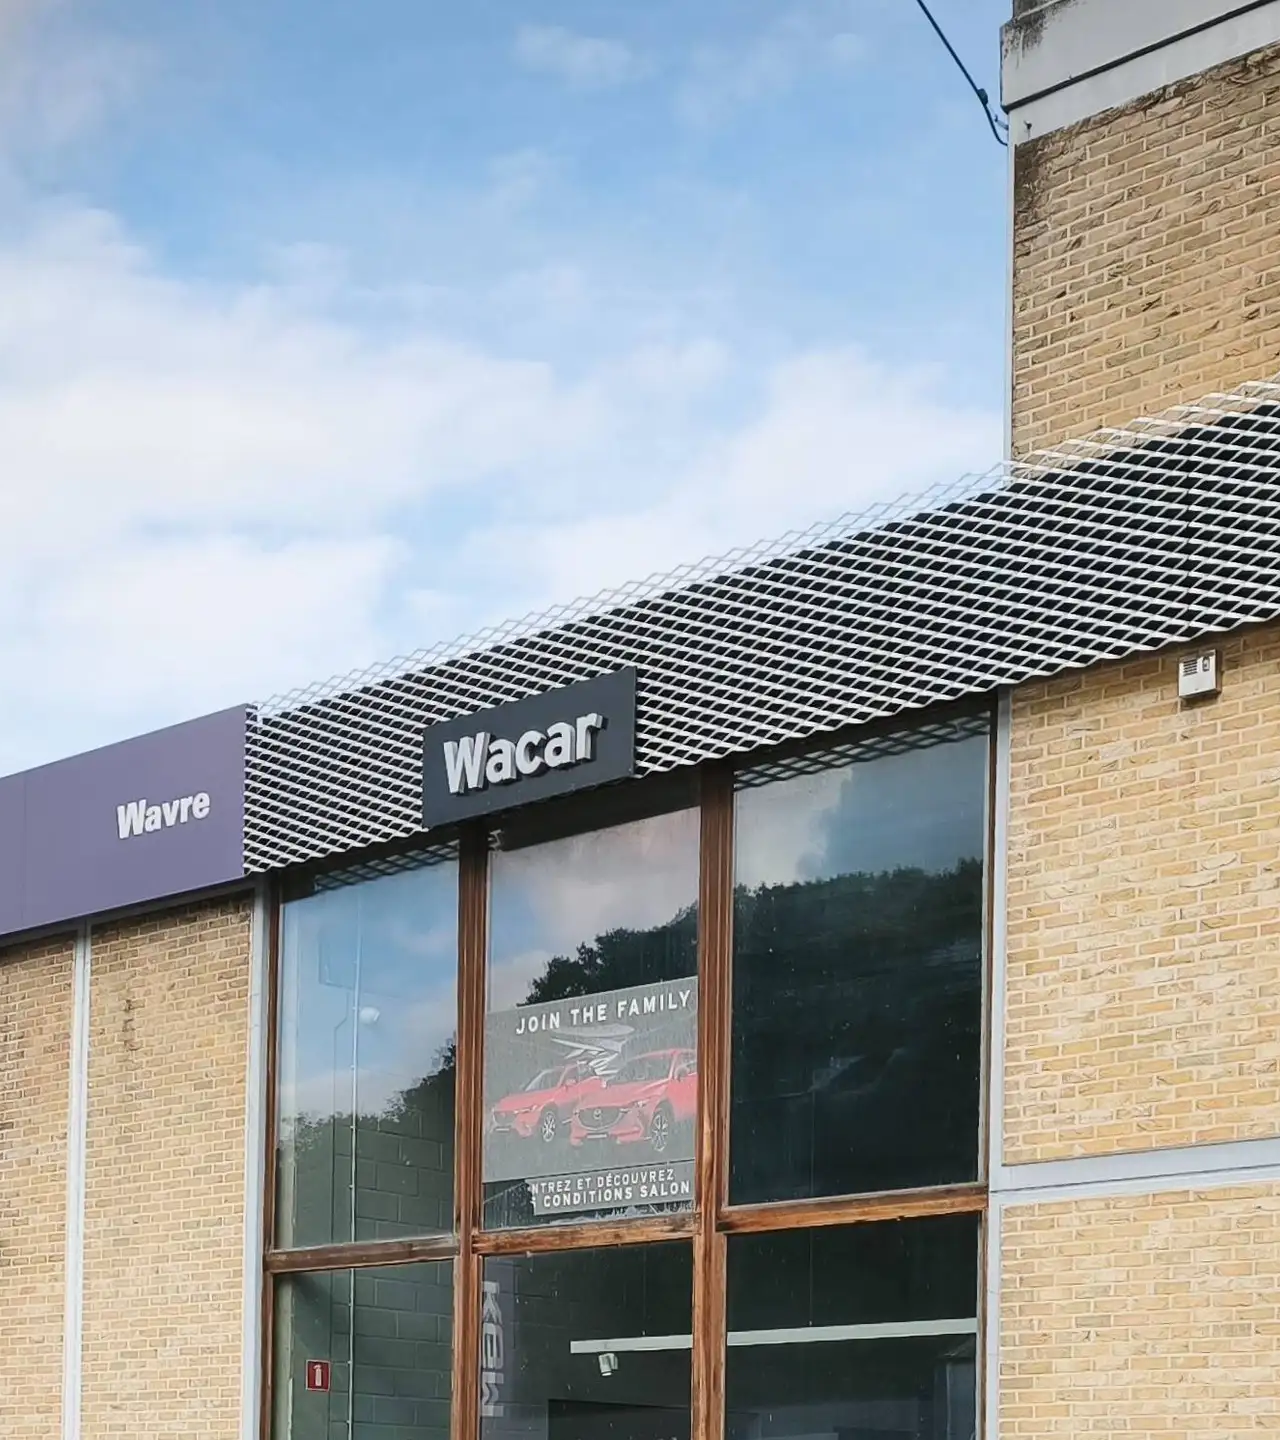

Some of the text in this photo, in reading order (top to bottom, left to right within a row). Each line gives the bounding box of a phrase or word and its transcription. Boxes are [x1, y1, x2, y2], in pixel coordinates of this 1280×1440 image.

[444, 712, 604, 794] Wacar
[116, 791, 211, 839] Wavre
[515, 989, 691, 1035] JOIN THE FAMILY
[543, 1187, 633, 1208] CONDITIONS
[640, 1180, 690, 1198] SALON
[577, 1177, 592, 1190] ET
[597, 1168, 675, 1188] DÉCOUVREZ
